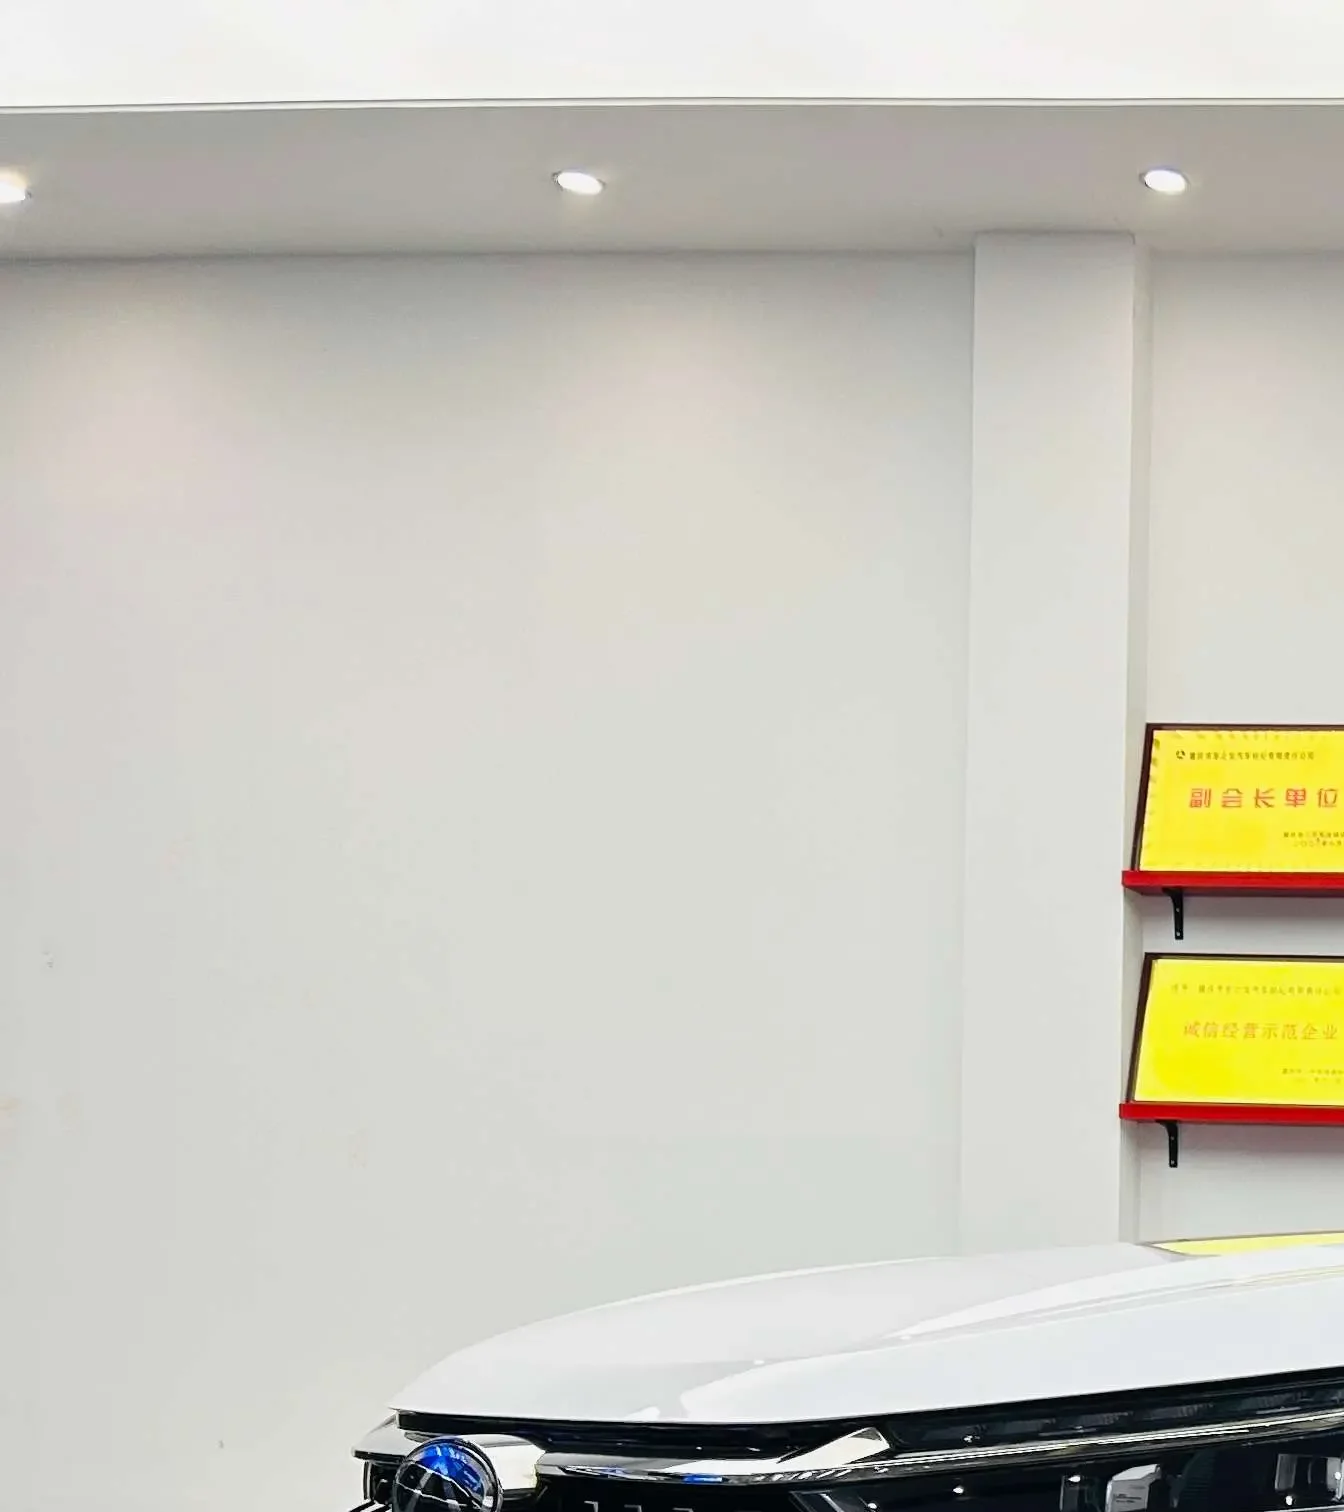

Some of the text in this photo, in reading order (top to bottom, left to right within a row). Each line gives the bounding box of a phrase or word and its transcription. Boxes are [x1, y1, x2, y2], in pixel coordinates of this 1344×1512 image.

[1189, 788, 1339, 809] 副会长单位
[1183, 1020, 1338, 1041] 诚信经营示范企业
